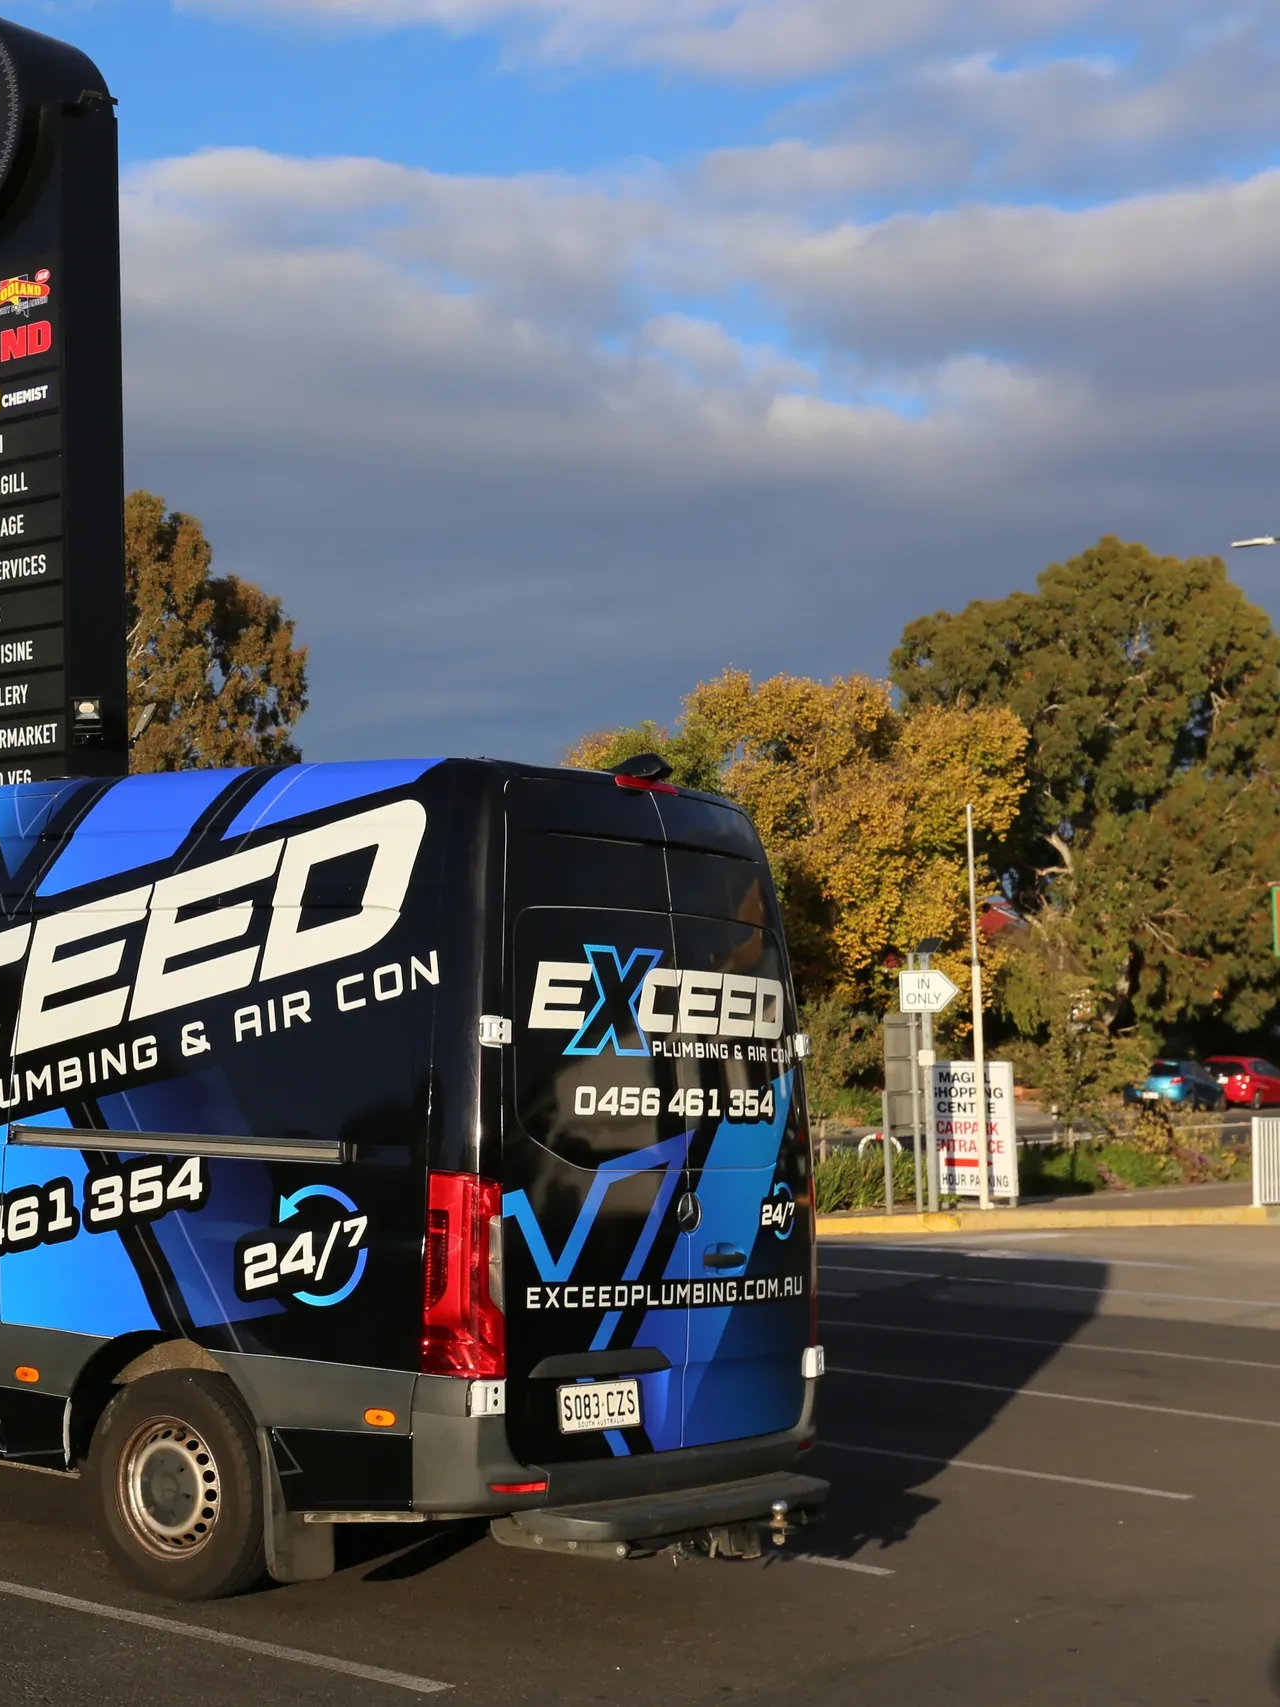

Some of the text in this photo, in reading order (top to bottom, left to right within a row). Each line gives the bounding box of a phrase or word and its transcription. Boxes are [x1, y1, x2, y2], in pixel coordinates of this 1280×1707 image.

[1, 385, 48, 408] CHEMIST
[917, 977, 930, 989] IN
[181, 1021, 210, 1057] &
[234, 989, 311, 1043] AIR
[337, 950, 440, 1013] CON
[528, 944, 784, 1056] EXCEED
[906, 992, 941, 1005] ONLY
[652, 1040, 729, 1060] PLUMBING
[734, 1044, 743, 1060] &
[748, 1046, 768, 1062] AIR
[938, 1072, 990, 1084] MAGIL
[574, 1086, 774, 1117] 0456 461 354
[934, 1086, 1004, 1099] HOPPNG
[937, 1101, 996, 1113] CENTE
[936, 1139, 1004, 1154] NTRACE
[89, 1157, 203, 1224] 354
[942, 1173, 1009, 1187] HOUR PAKING
[761, 1201, 795, 1228] 24/7
[244, 1215, 368, 1291] 24/7
[526, 1275, 803, 1310] EXCEEDPLUMBING.COM.AU
[578, 1418, 624, 1428] SOUTH AUSTRALIA
